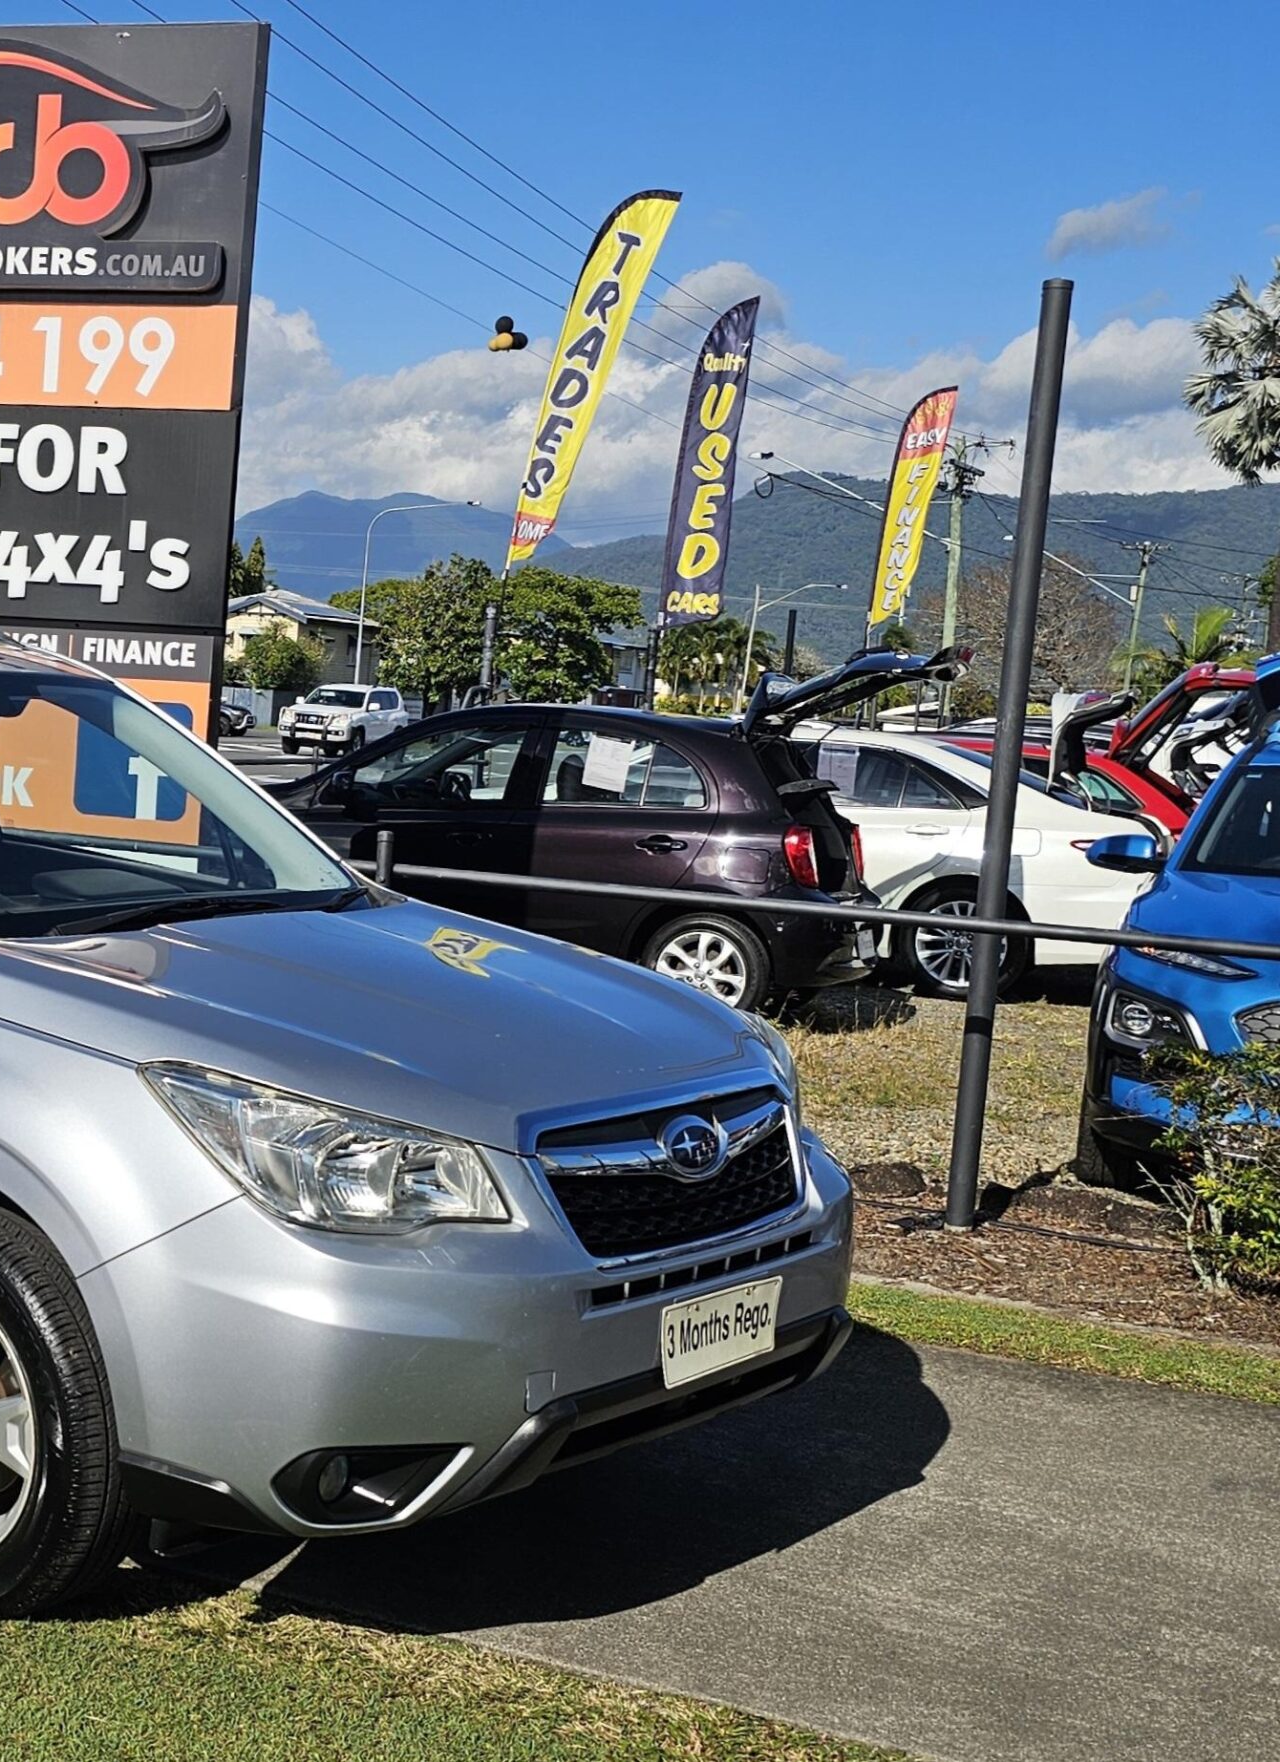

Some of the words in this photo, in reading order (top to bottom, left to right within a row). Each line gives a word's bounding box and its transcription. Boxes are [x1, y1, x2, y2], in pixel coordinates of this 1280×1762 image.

[33, 315, 175, 397] 199
[524, 232, 641, 499] TRADES
[906, 428, 947, 449] EASY
[676, 383, 737, 579] USED
[881, 463, 928, 610] FINANCE
[667, 591, 719, 615] CARS
[82, 637, 196, 667] FINANCE
[667, 1324, 675, 1358] 3
[680, 1310, 730, 1355] Months
[733, 1302, 771, 1340] Rego.
